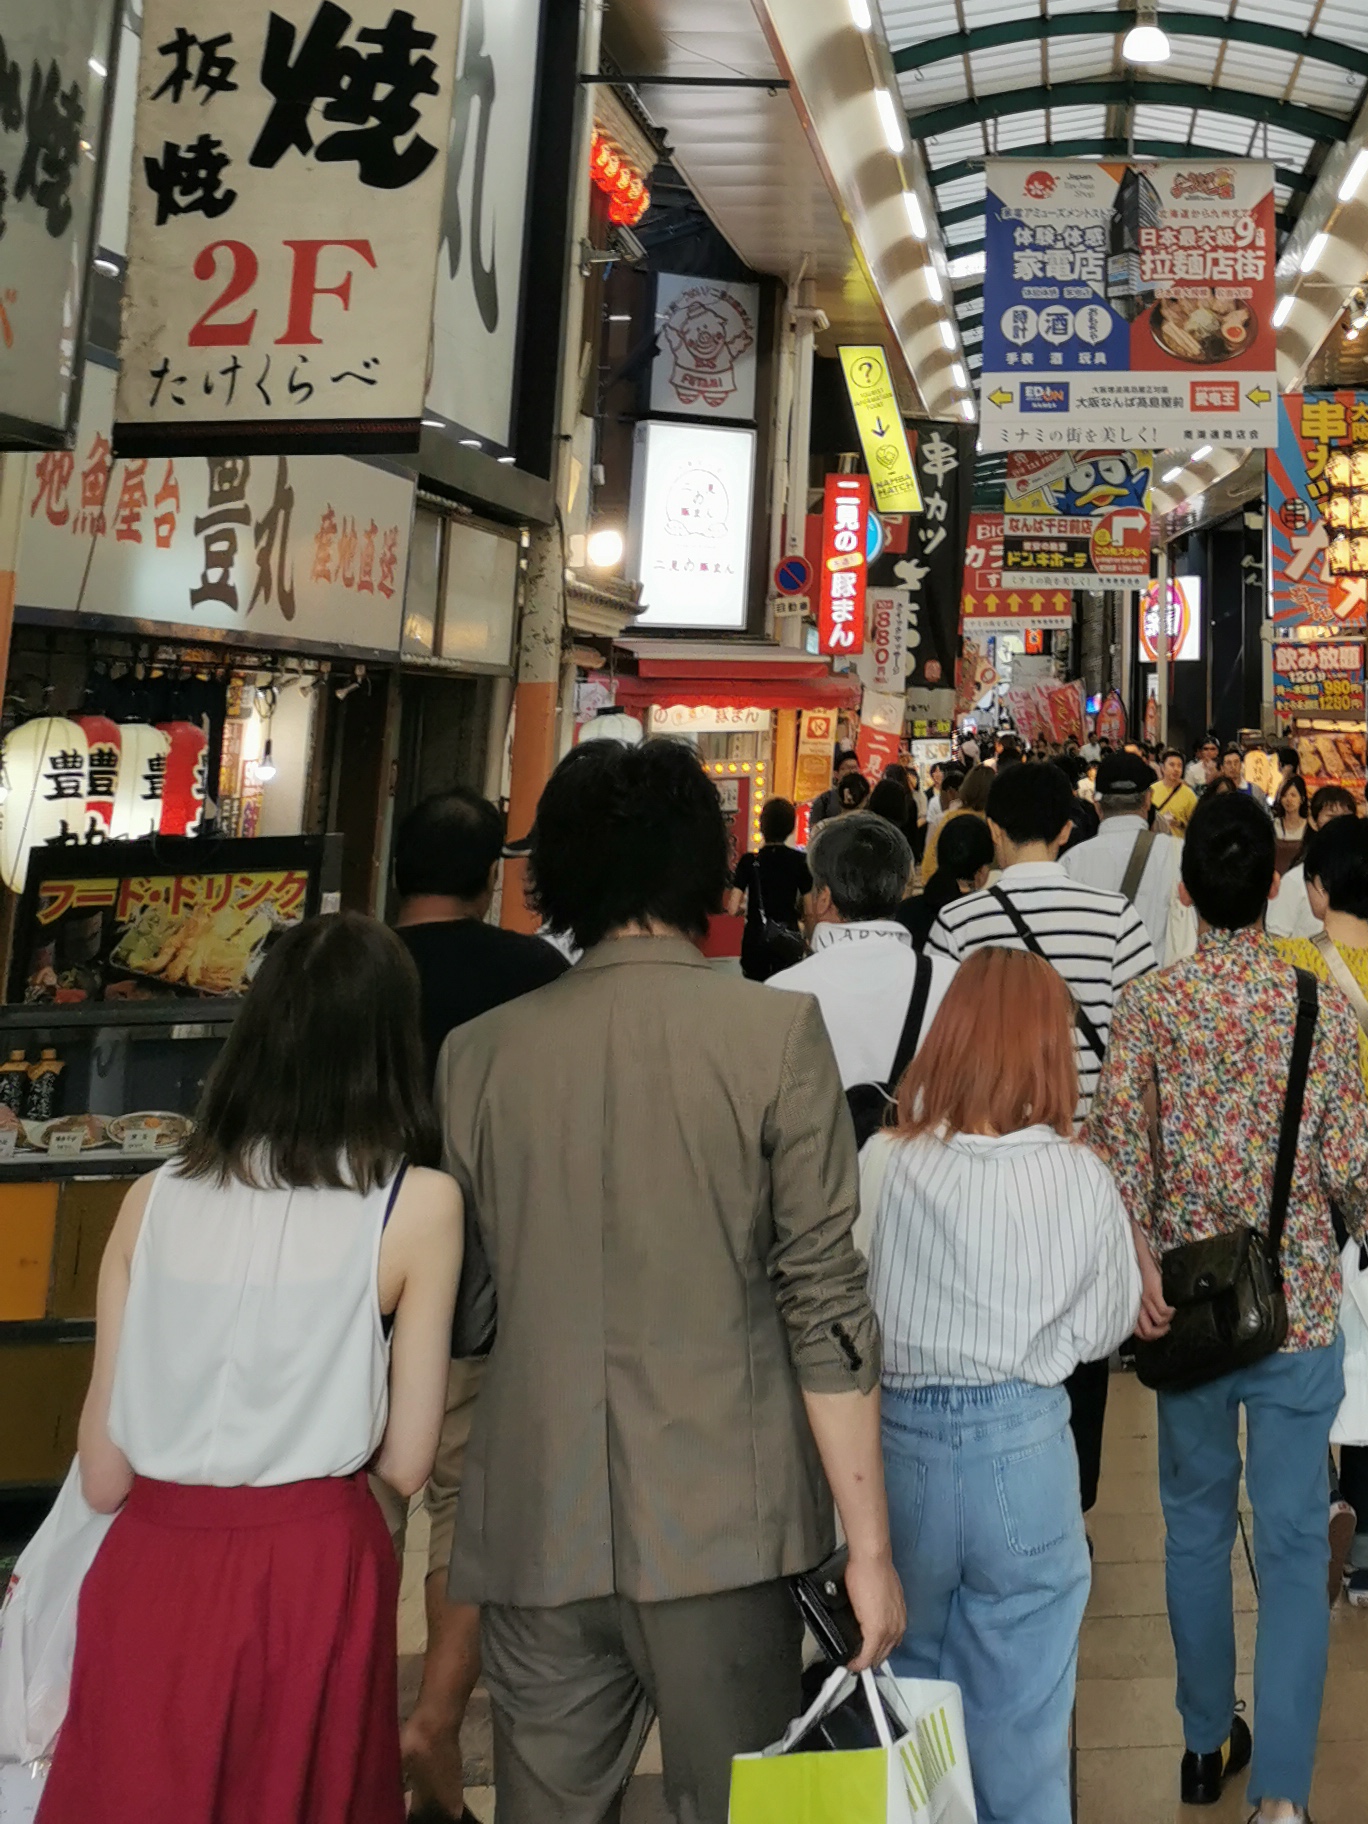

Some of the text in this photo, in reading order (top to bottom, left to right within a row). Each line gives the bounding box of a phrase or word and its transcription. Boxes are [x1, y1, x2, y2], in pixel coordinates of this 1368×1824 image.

[1013, 249, 1105, 281] 家電店
[188, 239, 378, 348] 2F
[1045, 312, 1069, 336] 酒
[150, 354, 379, 409] たけくらべ
[918, 431, 959, 554] 串カツ
[776, 601, 809, 614] 自動車
[1275, 645, 1361, 671] 飲み放題
